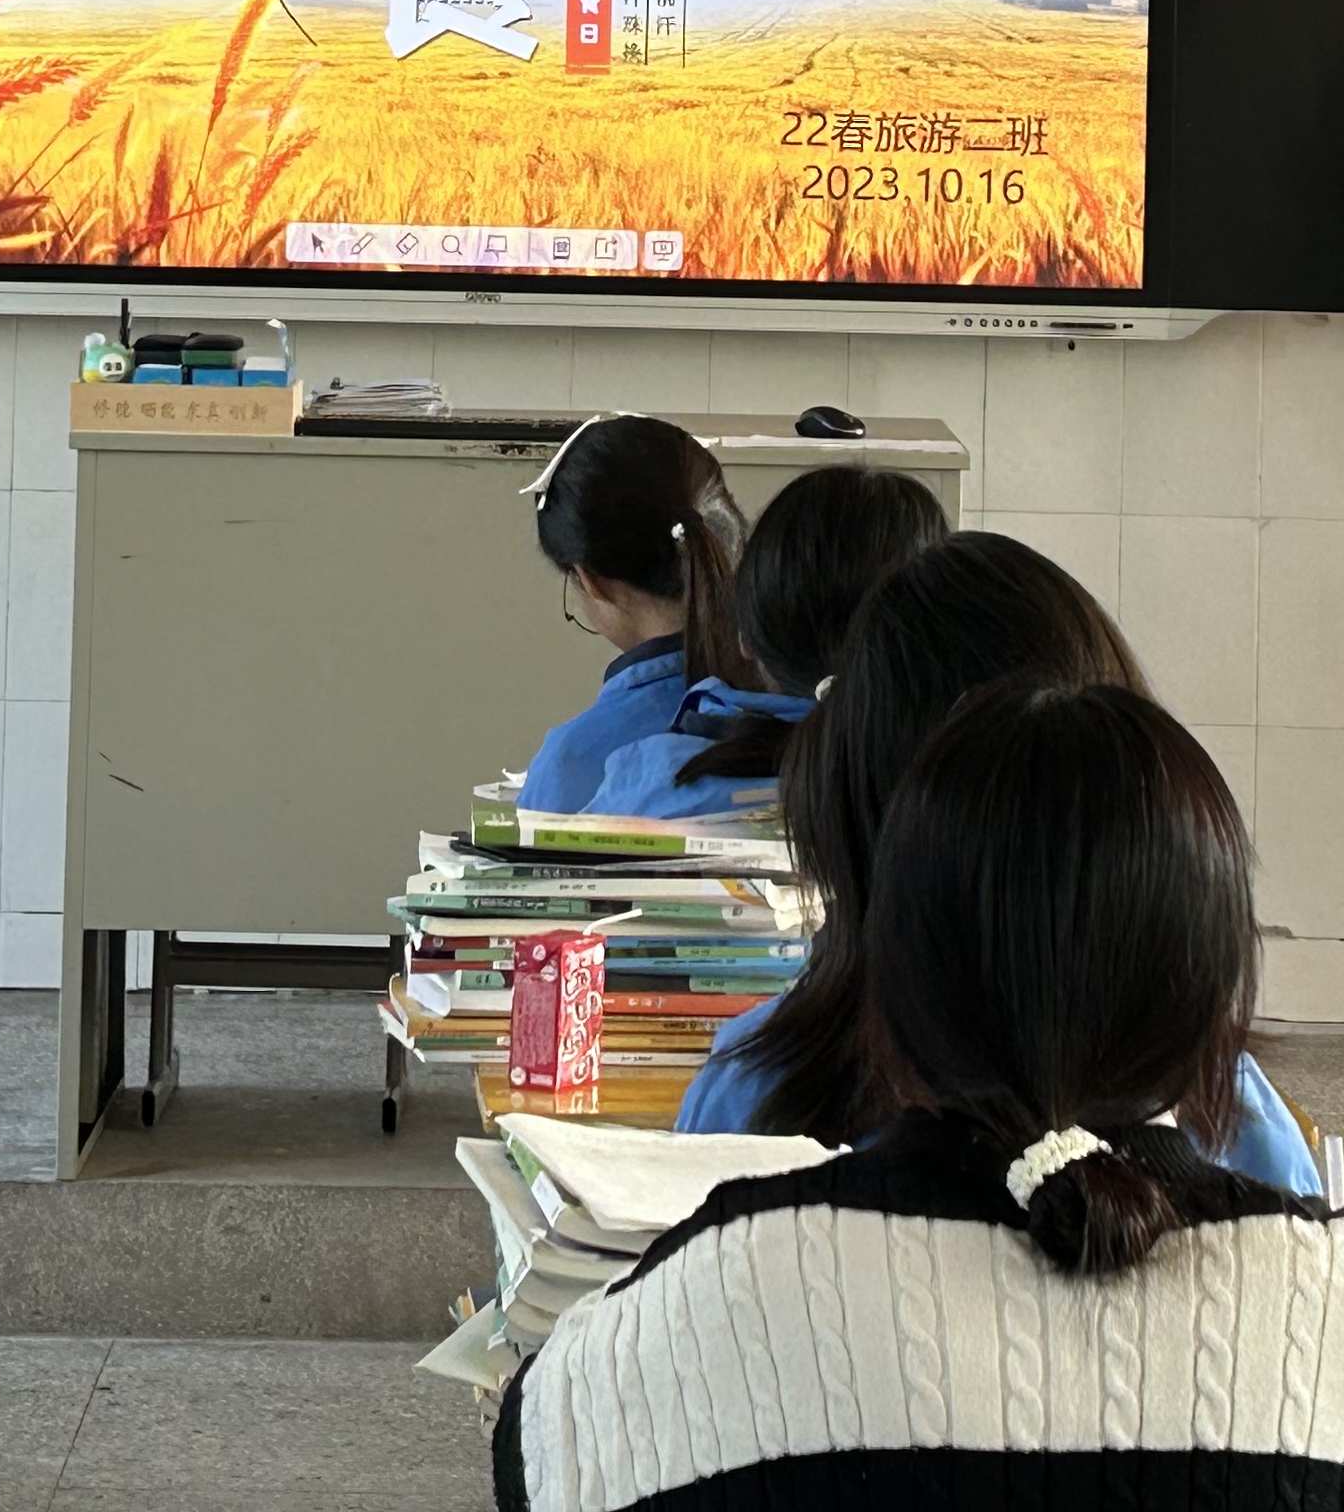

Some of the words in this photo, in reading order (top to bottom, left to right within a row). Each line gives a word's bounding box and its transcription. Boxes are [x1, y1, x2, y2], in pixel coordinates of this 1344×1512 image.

[780, 110, 1049, 157] 22春旅游二班
[801, 164, 1026, 206] 2023.10.16
